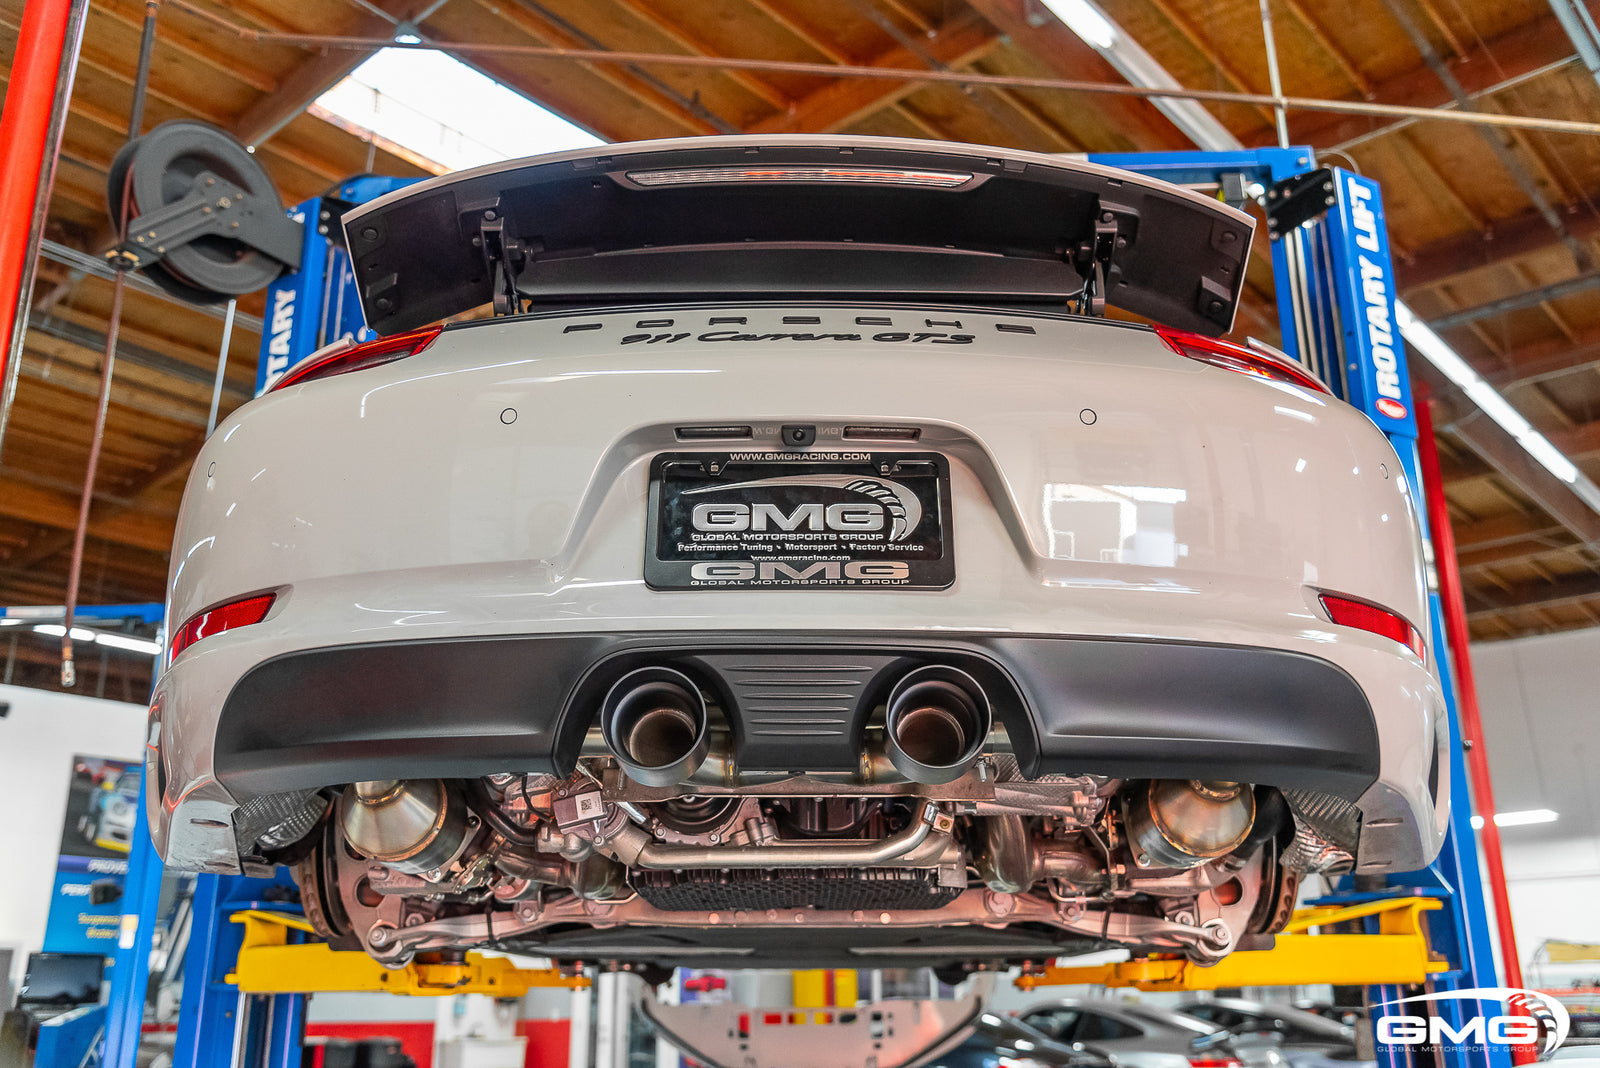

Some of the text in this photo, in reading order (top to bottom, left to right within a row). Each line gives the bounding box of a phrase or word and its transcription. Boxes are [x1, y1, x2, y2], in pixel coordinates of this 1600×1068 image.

[1347, 176, 1402, 399] ROTARY LIFT
[620, 331, 976, 345] 911 Carrera GTS
[730, 453, 871, 461] WWW.GMGRACING.COM
[692, 502, 884, 532] GMG
[691, 533, 884, 541] GLOBAL MOTORSPORTS GROUP
[678, 543, 924, 552] Performance Tuning Motorsport Factory Service
[691, 561, 910, 580] GMG
